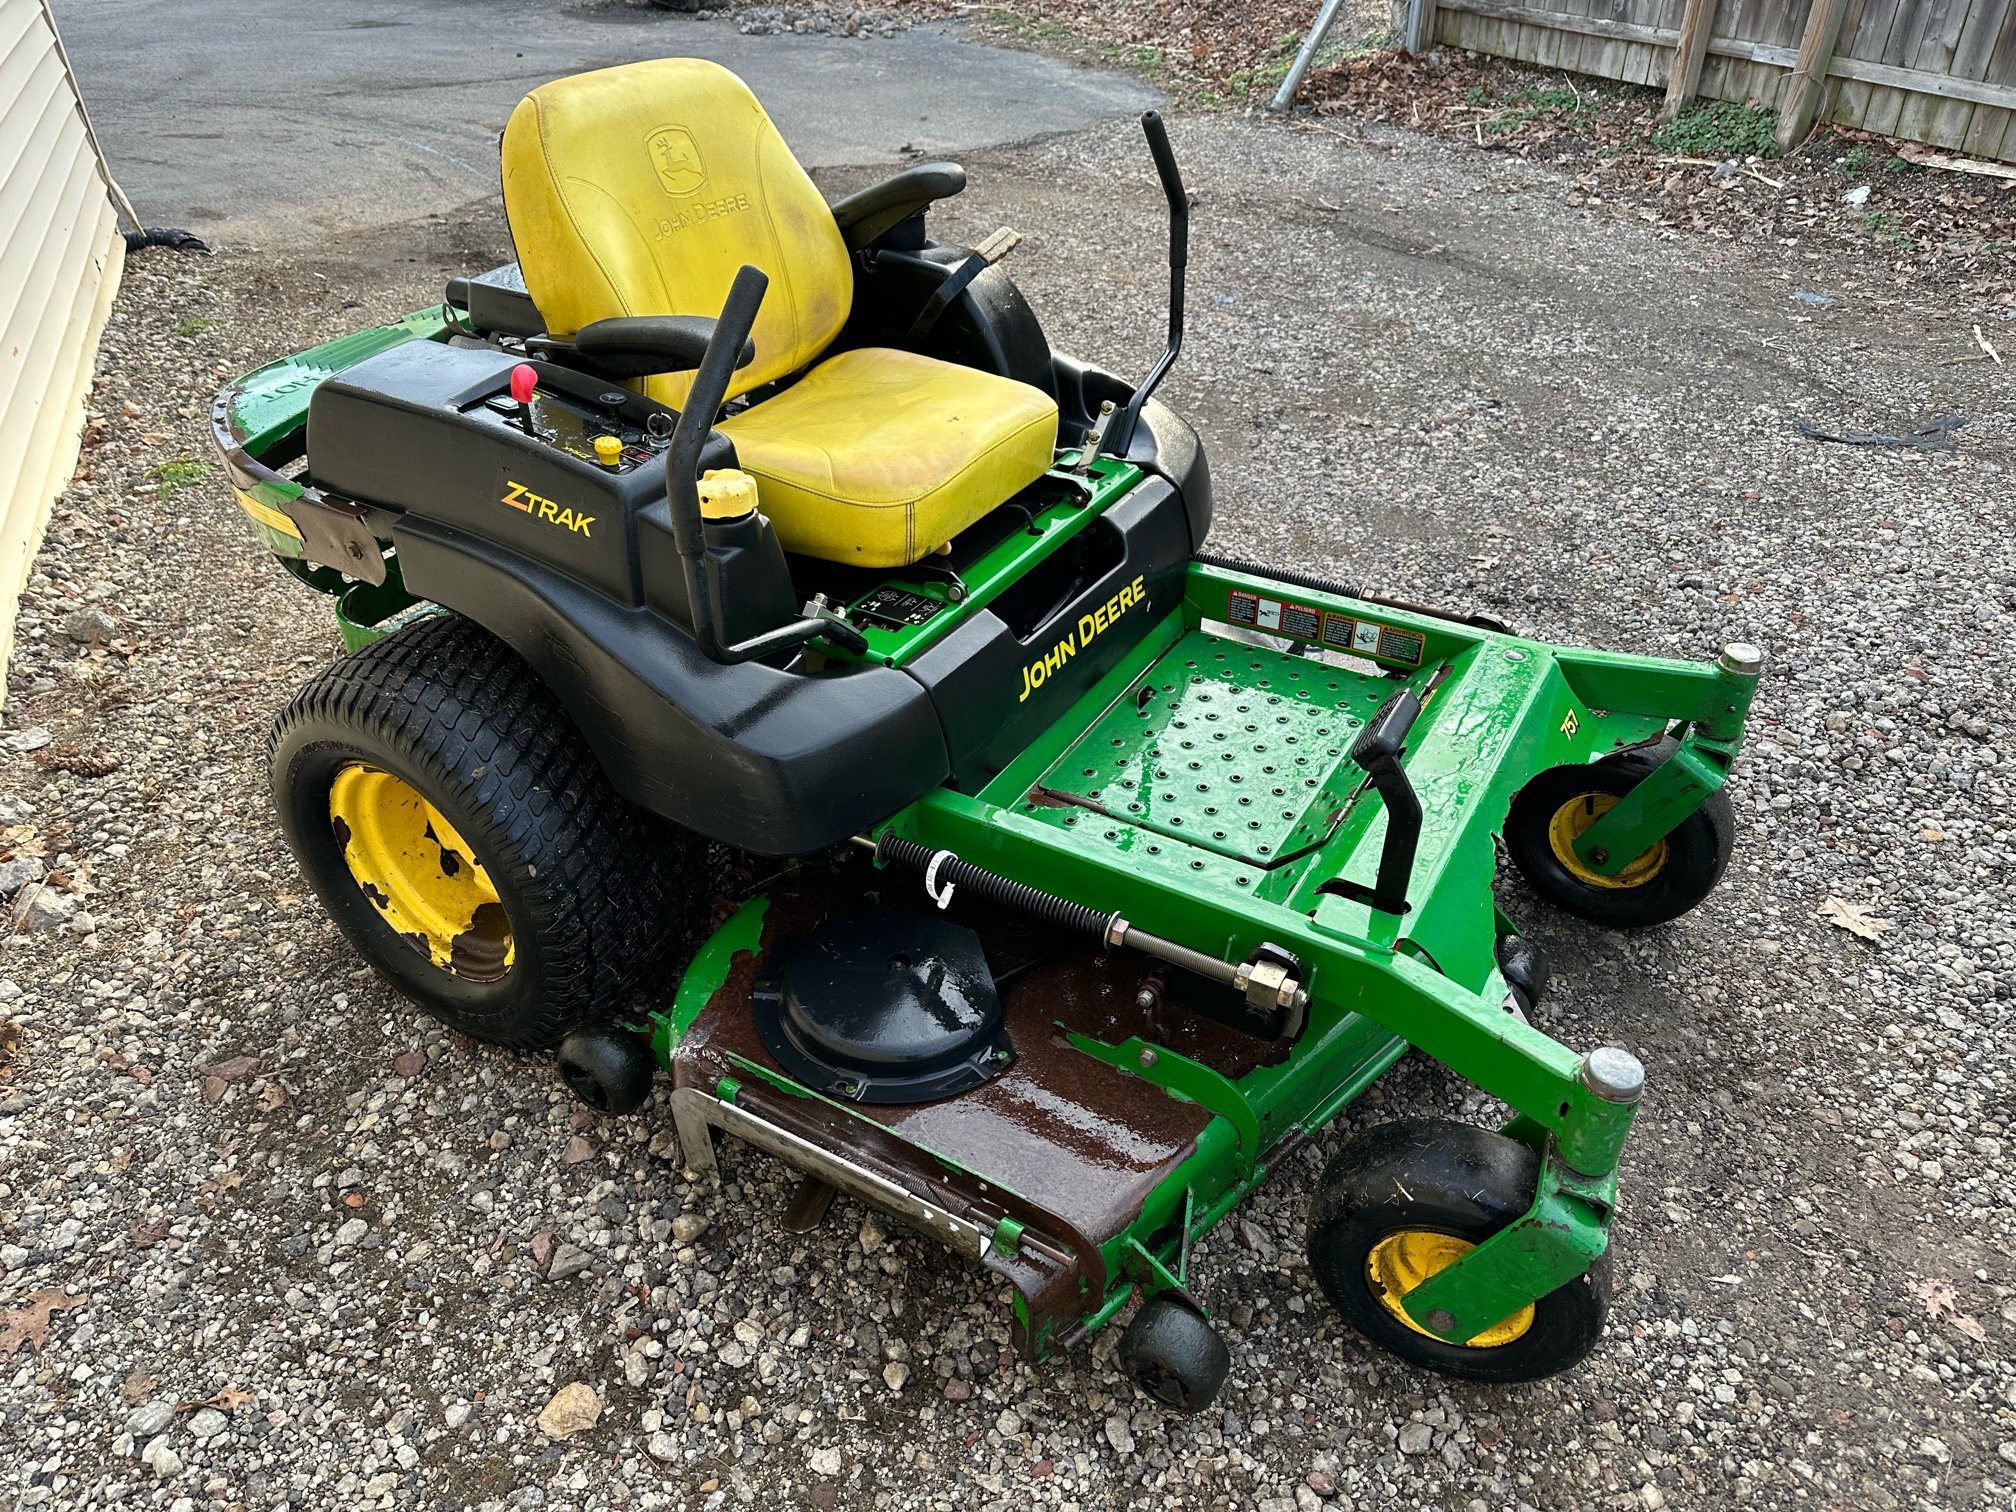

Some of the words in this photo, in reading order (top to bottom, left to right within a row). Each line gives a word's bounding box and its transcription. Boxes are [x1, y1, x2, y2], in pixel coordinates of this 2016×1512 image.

[654, 209, 695, 241] JOHN
[691, 193, 750, 225] DEERE
[1019, 632, 1076, 703] JOHN
[1078, 574, 1146, 648] DEERE
[1560, 708, 1579, 741] 757
